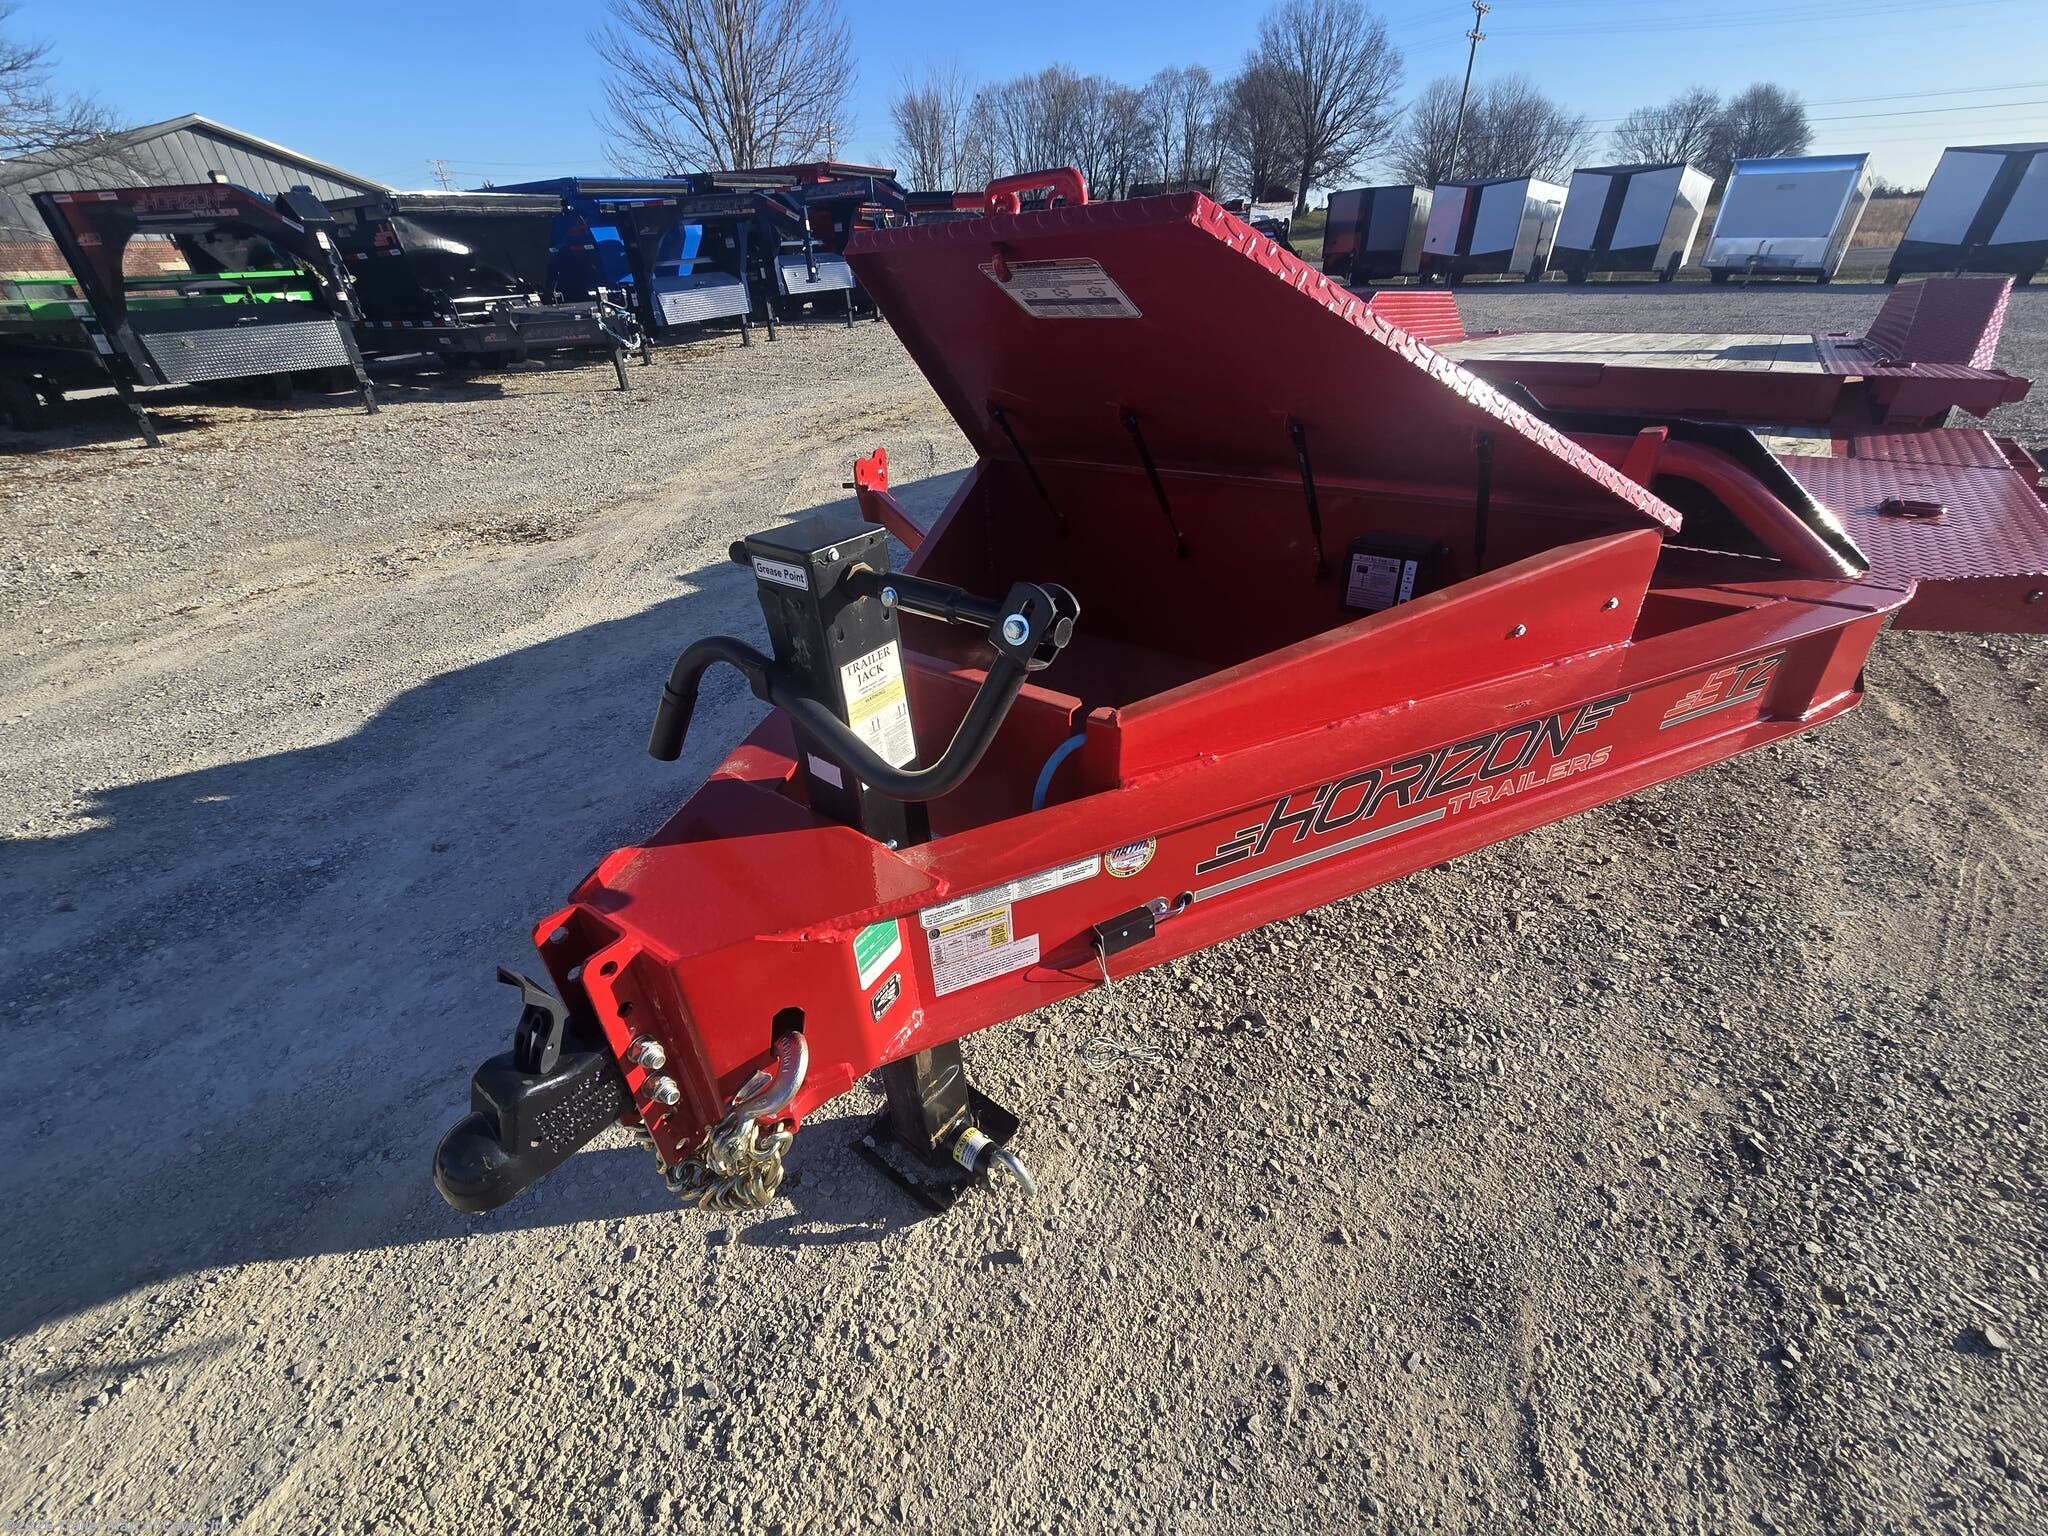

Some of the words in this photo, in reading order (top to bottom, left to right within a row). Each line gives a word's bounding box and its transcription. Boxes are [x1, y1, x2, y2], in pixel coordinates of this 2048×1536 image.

[756, 562, 782, 578] Grease
[783, 569, 805, 583] Point
[845, 646, 891, 677] TRAILER
[857, 664, 885, 686] JACK
[1254, 704, 1589, 855] HORIZON
[1447, 745, 1613, 815] TRAILERS
